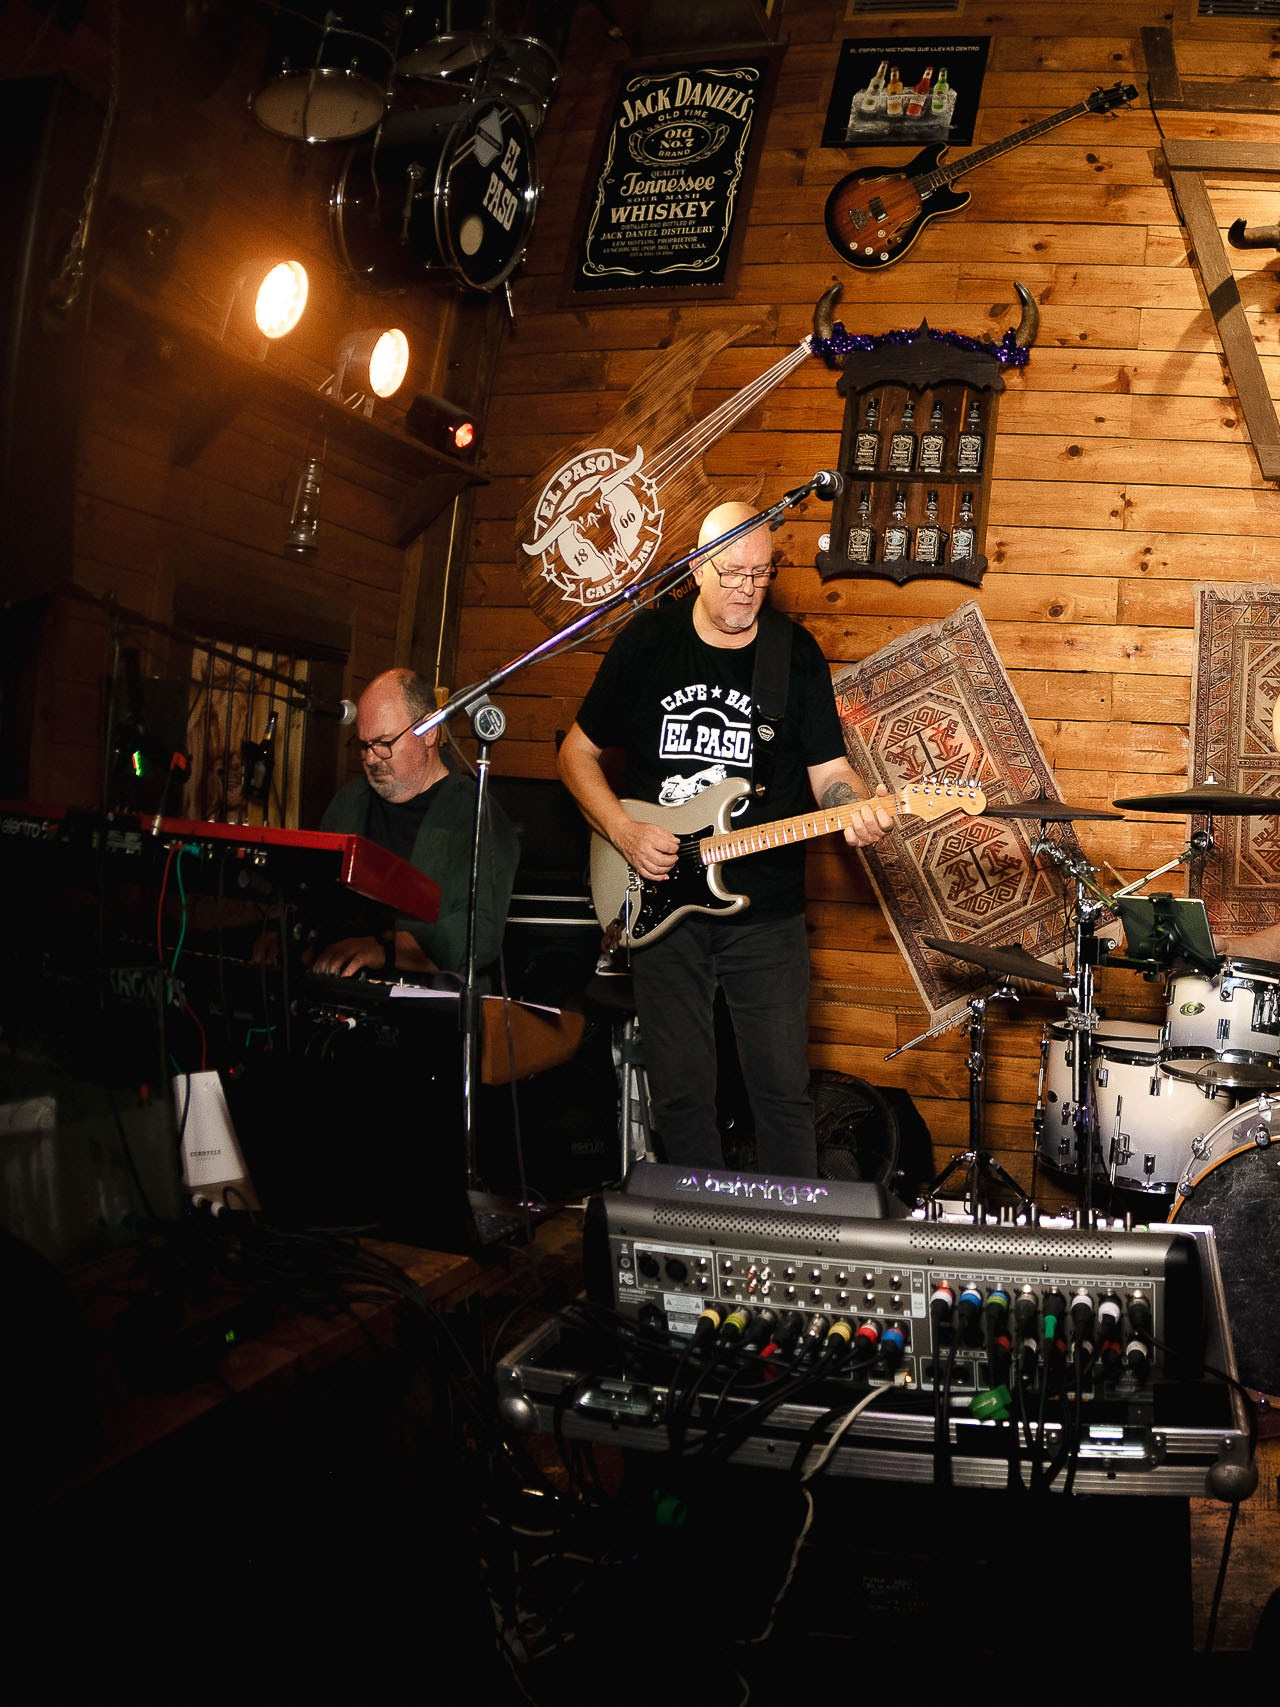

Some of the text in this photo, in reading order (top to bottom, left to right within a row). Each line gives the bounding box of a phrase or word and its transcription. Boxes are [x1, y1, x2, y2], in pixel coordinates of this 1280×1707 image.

[619, 87, 671, 128] JACK
[658, 107, 710, 121] OLD TIME
[664, 128, 693, 140] Old
[501, 136, 522, 183] EL
[658, 148, 692, 158] BRAND
[620, 172, 716, 197] Tennessee
[650, 169, 688, 179] QUALITY
[482, 171, 519, 231] PASO
[626, 193, 701, 205] SOUR MASH
[610, 200, 717, 224] WHISKEY
[600, 225, 716, 241] JACK DANIEL DISTILLERY
[540, 455, 612, 520] EL PASO
[618, 509, 636, 529] 66
[572, 548, 590, 568] 18
[631, 540, 656, 573] BAR
[660, 683, 752, 719] CAFE BA
[663, 722, 752, 761] EL PASO
[704, 1172, 829, 1207] behringer
